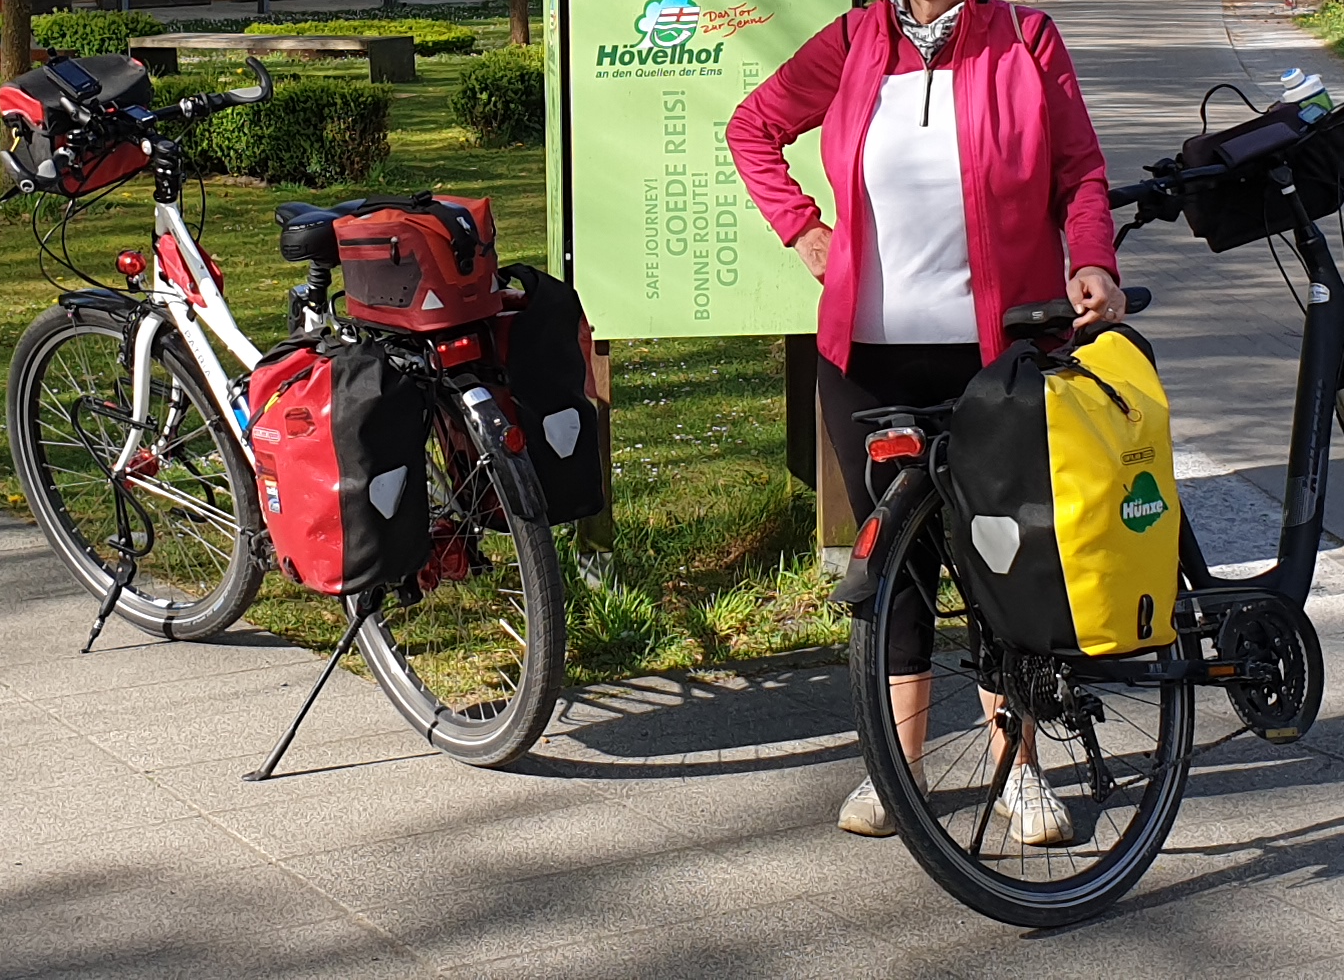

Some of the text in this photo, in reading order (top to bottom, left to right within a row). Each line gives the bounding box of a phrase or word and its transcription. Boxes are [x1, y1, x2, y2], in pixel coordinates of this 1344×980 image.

[700, 12, 775, 38] zur Senne
[702, 2, 758, 23] Das Tor
[596, 42, 725, 67] Hövelhof
[595, 67, 723, 79] an den Quellen der Ems
[662, 90, 688, 256] GOEDE REIS!
[644, 178, 659, 299] SAFE JOURNEY!
[691, 172, 710, 320] BONNE ROUTE!
[716, 194, 739, 287] GOEDE
[1122, 497, 1164, 520] Hünxe
